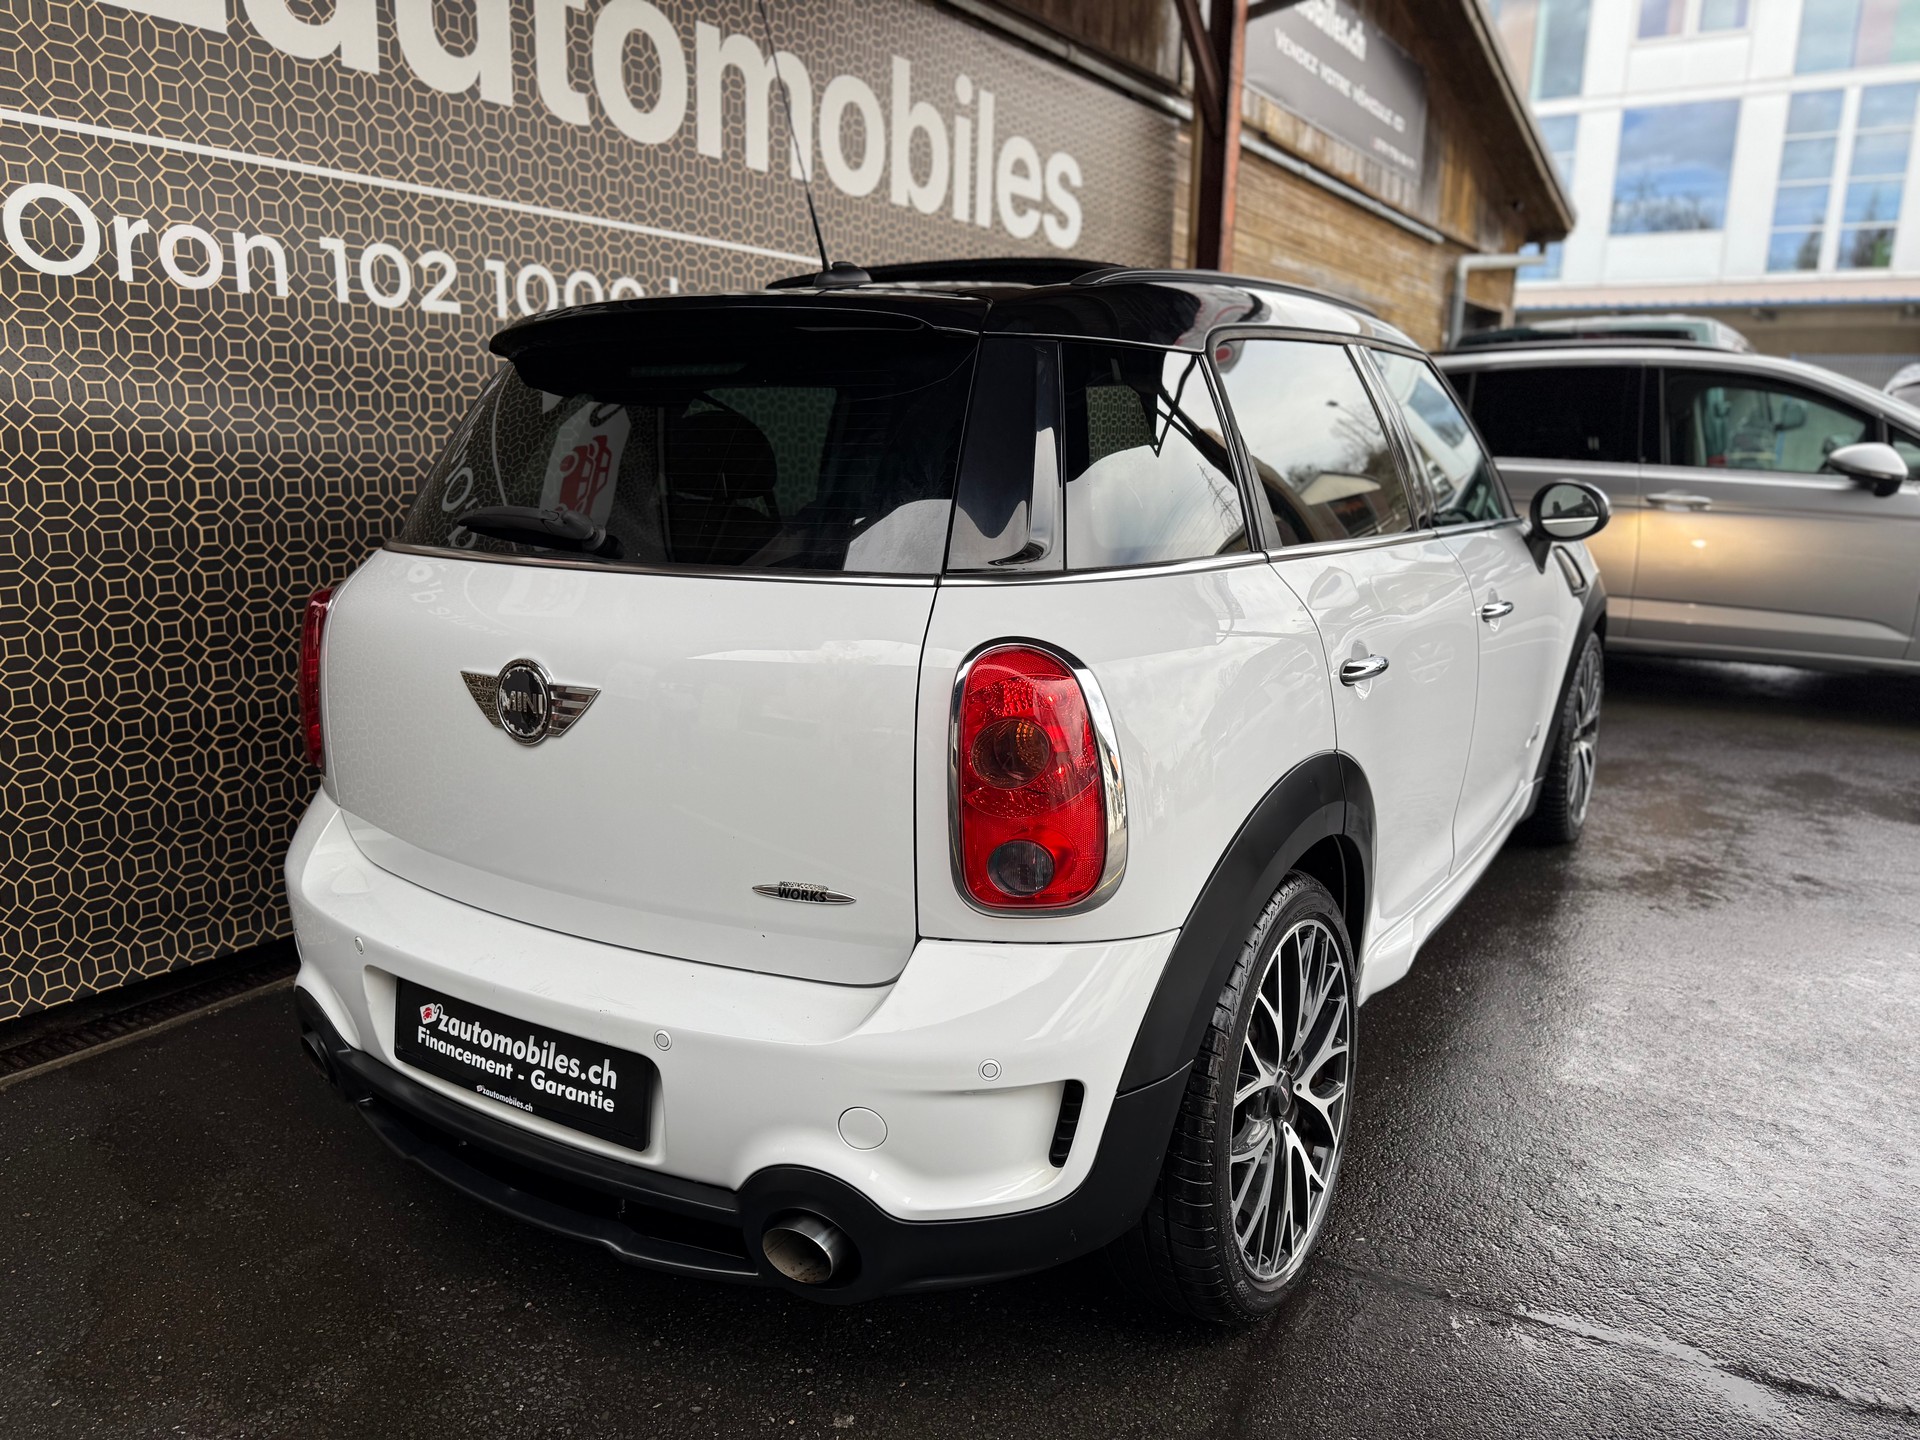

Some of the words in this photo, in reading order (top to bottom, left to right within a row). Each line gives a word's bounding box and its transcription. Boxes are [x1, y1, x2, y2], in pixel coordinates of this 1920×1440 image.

[2, 182, 289, 298] Oron
[319, 236, 461, 314] 102
[500, 689, 544, 715] MINI
[778, 887, 828, 903] WORKS
[417, 1025, 514, 1080] Financement
[517, 1073, 525, 1081] -
[530, 1069, 616, 1113] Garantie
[437, 1012, 618, 1090] zautomobiles.ch
